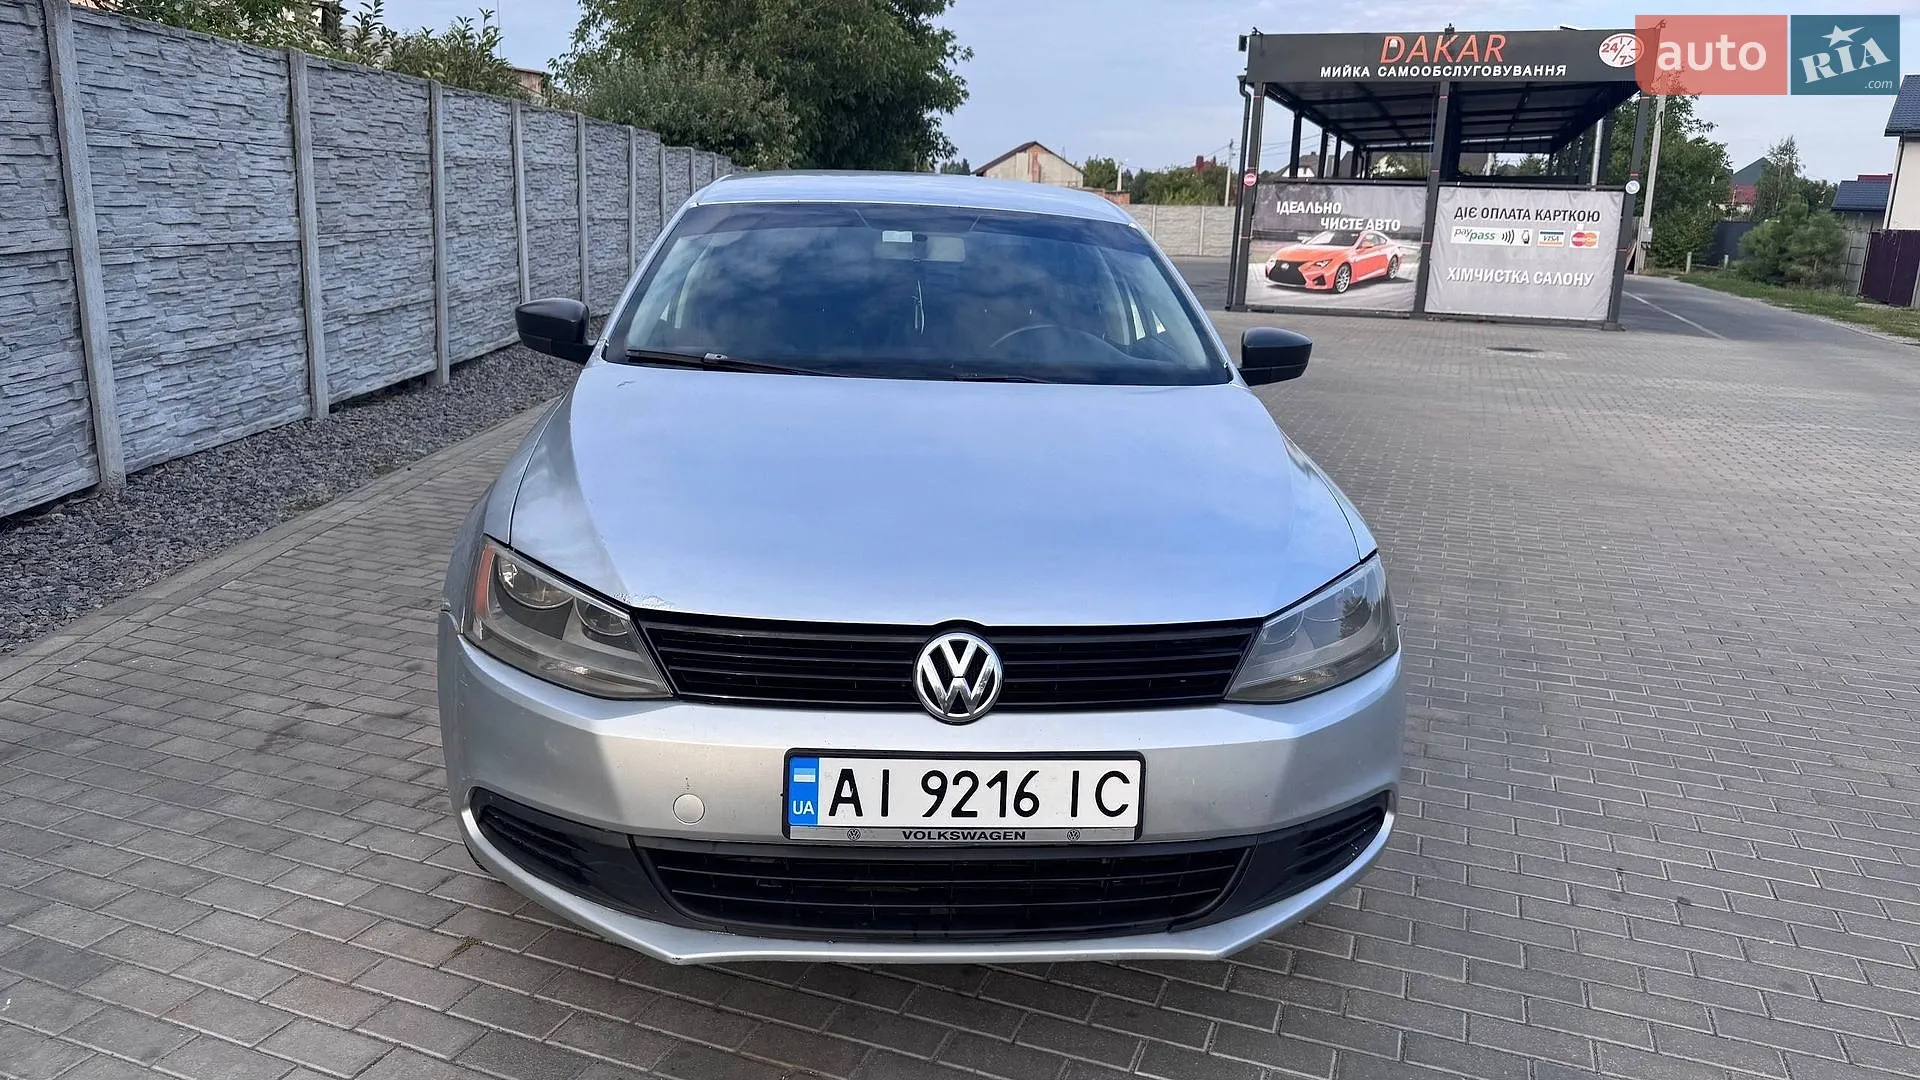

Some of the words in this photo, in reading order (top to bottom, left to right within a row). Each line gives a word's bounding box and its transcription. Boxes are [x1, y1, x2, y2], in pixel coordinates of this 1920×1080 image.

[1380, 34, 1507, 64] DAKAR
[1320, 64, 1371, 78] МИЙКА
[1377, 64, 1567, 78] САМООБСЛУГОВУВАННЯ
[1276, 201, 1342, 215] ІДЕАЛЬНО
[1453, 206, 1478, 220] ДІЄ
[1481, 207, 1531, 221] ОПЛАТА
[1534, 209, 1601, 222] КАРТКОЮ
[1320, 218, 1363, 231] ЧИСТЕ
[1365, 218, 1402, 231] АВТО
[1446, 267, 1530, 284] ХІМЧИСТКА
[1533, 272, 1595, 287] САЛОНУ
[828, 768, 890, 818] AI
[921, 769, 1041, 818] 9216
[1071, 770, 1130, 818] IC
[792, 800, 816, 816] UA
[901, 830, 1027, 842] VOLKSWAGEN
